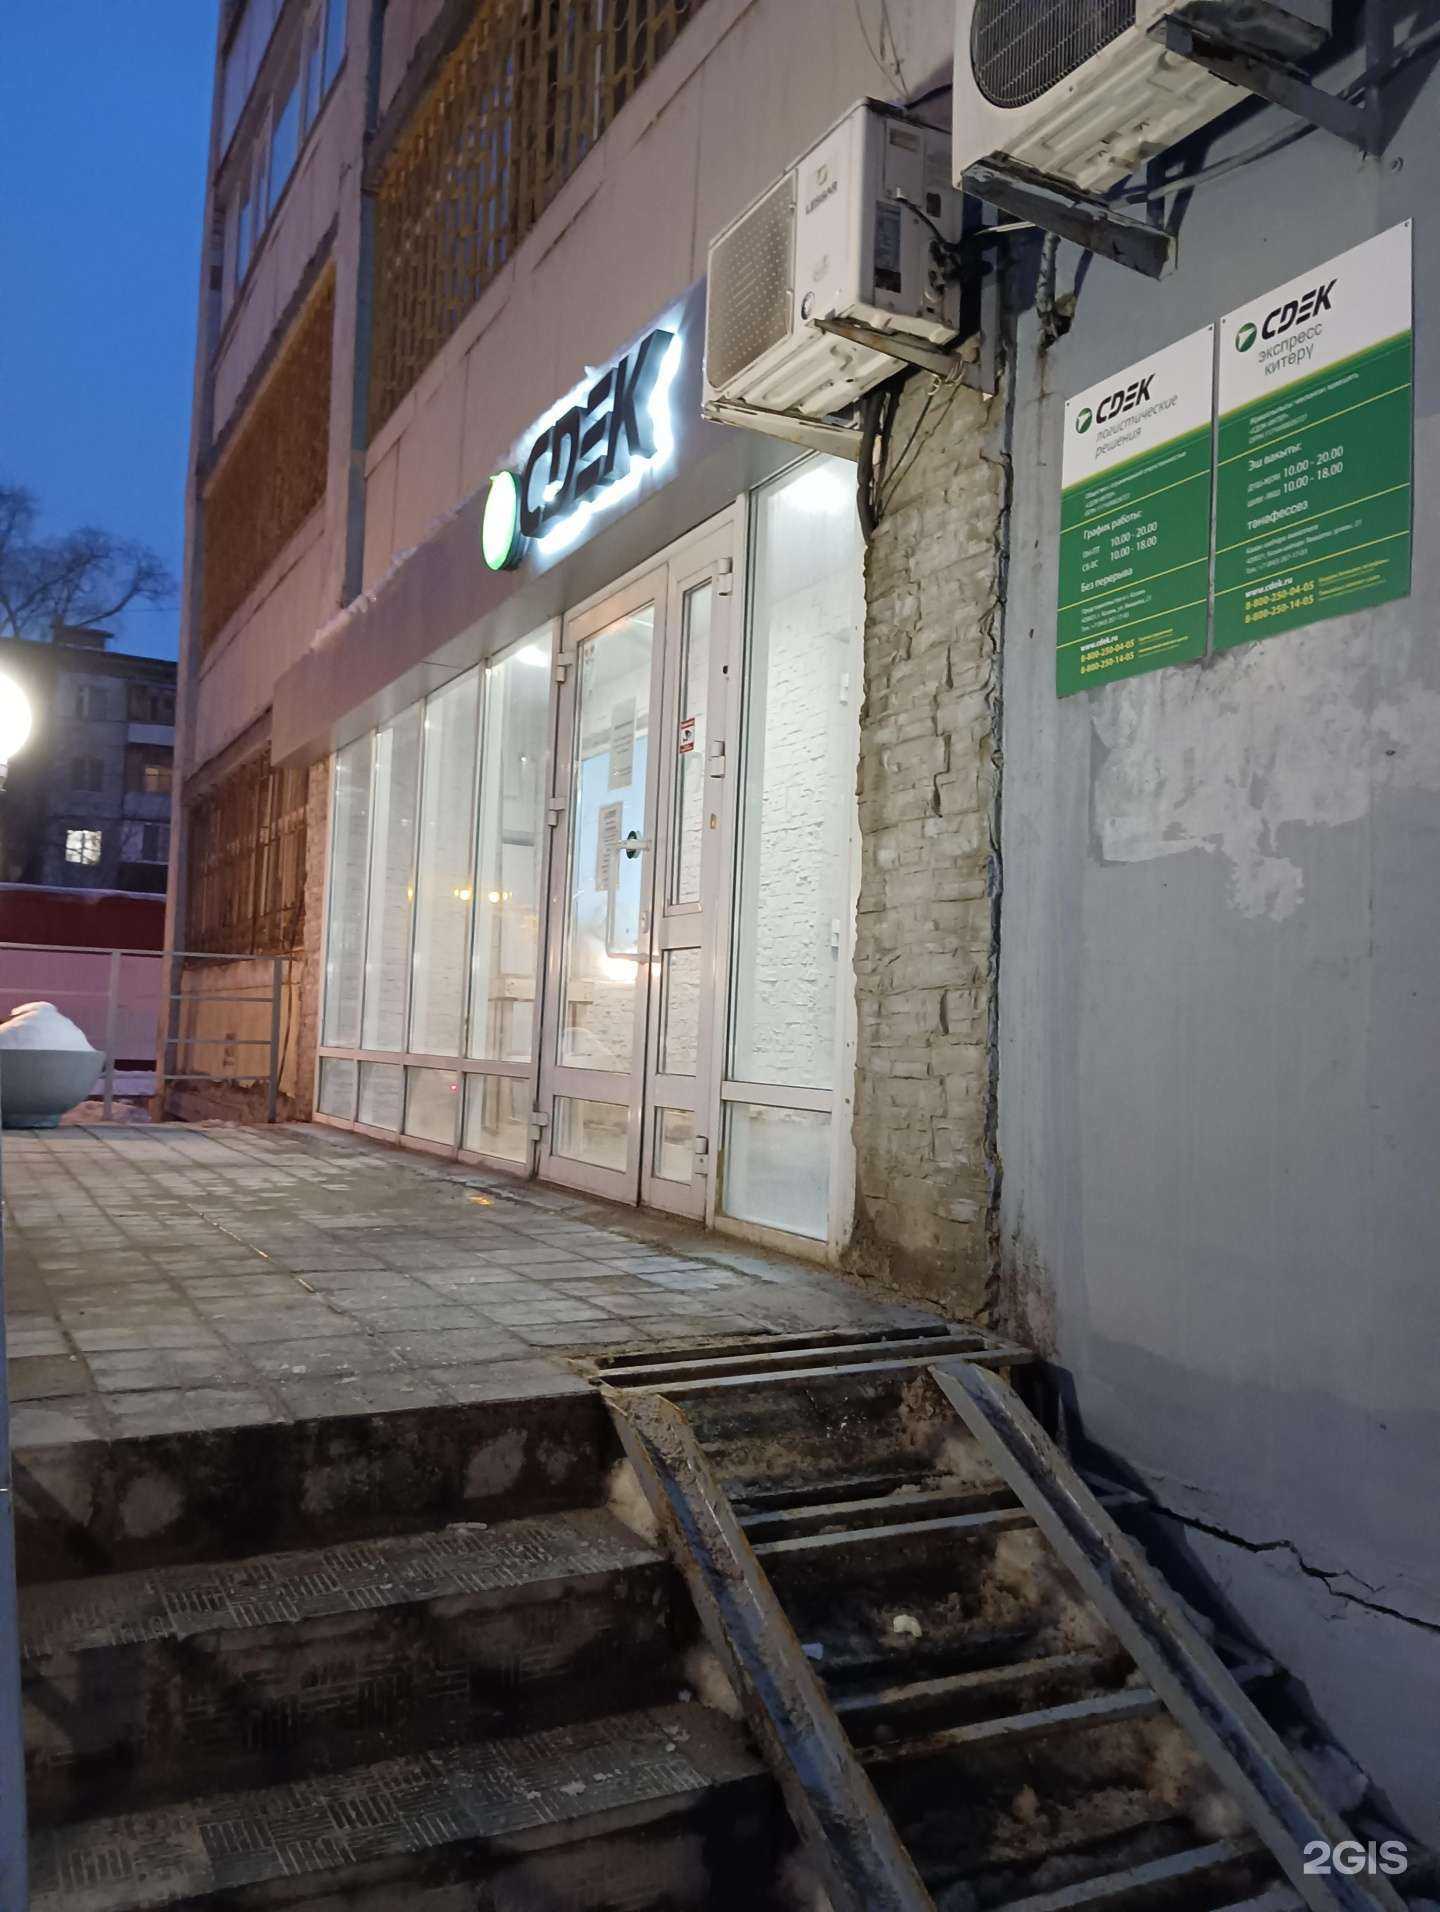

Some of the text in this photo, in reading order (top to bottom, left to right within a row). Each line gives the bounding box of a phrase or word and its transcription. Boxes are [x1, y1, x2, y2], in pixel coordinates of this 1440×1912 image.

[1261, 278, 1338, 340] CDEK
[1096, 373, 1156, 424] CDEK
[520, 328, 674, 538] CDEK
[1283, 475, 1309, 493] 10.00
[1317, 461, 1343, 480] 18.00
[1284, 460, 1309, 478] 10.00
[1317, 445, 1344, 465] 20.00
[1110, 546, 1130, 560] 10.00
[1137, 536, 1158, 551] 18.00
[1111, 532, 1131, 547] 10.00
[1136, 521, 1158, 538] 20.00
